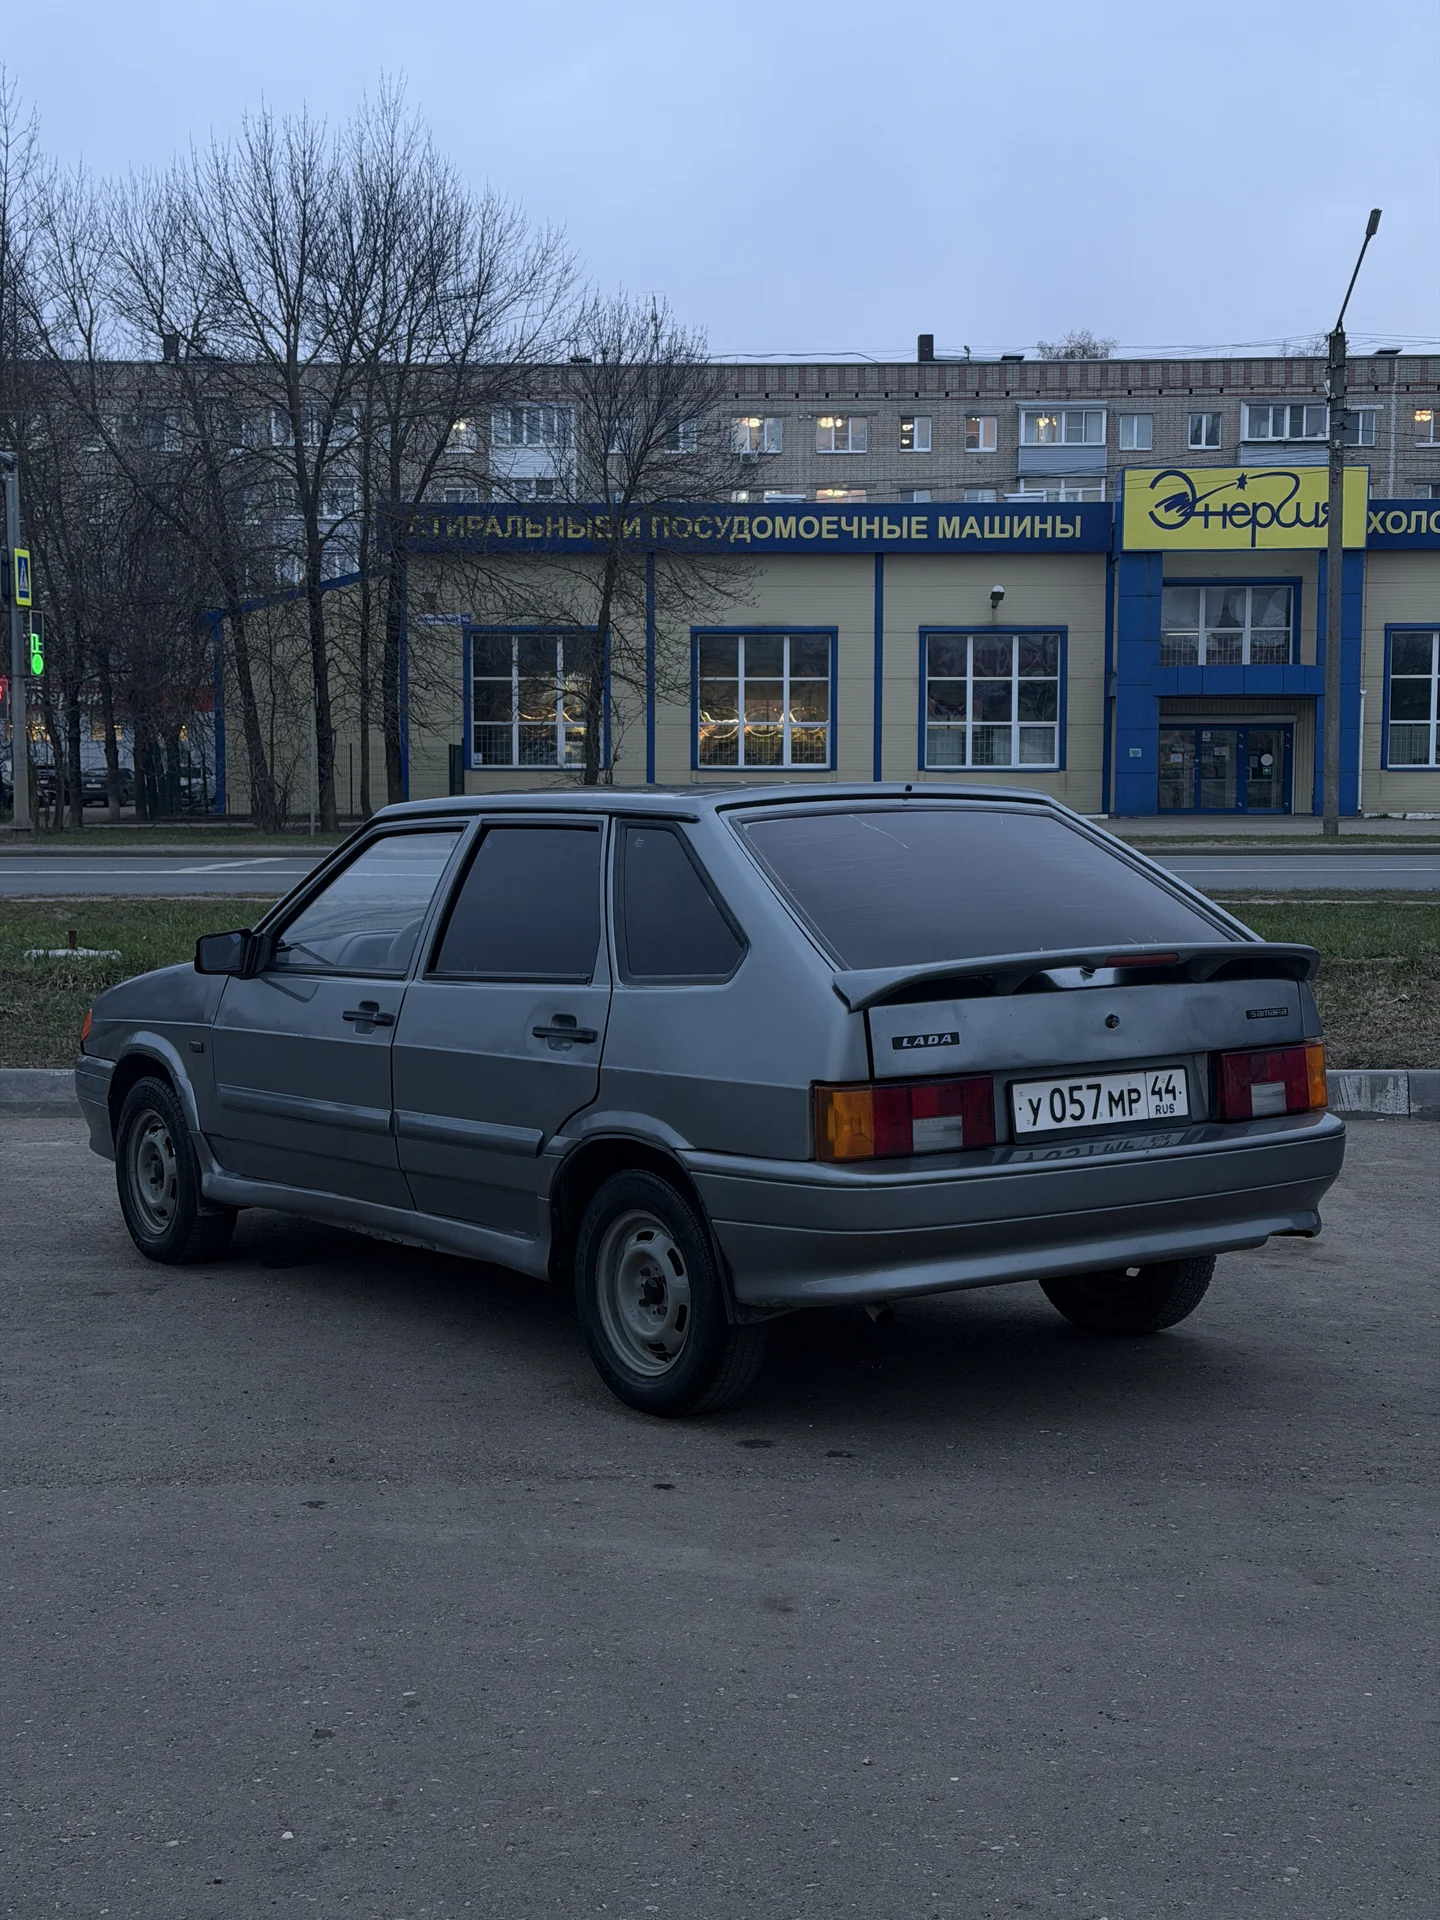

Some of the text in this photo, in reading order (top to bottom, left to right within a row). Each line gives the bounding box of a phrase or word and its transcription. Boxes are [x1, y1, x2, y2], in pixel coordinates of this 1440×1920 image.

[622, 516, 640, 538] И
[651, 515, 928, 543] ПОСУДОМОЕЧНЫЕ
[938, 515, 1082, 539] МАШИНЫ
[902, 1034, 952, 1047] LADA
[1151, 1074, 1177, 1102] 44
[1155, 1103, 1176, 1115] RUS
